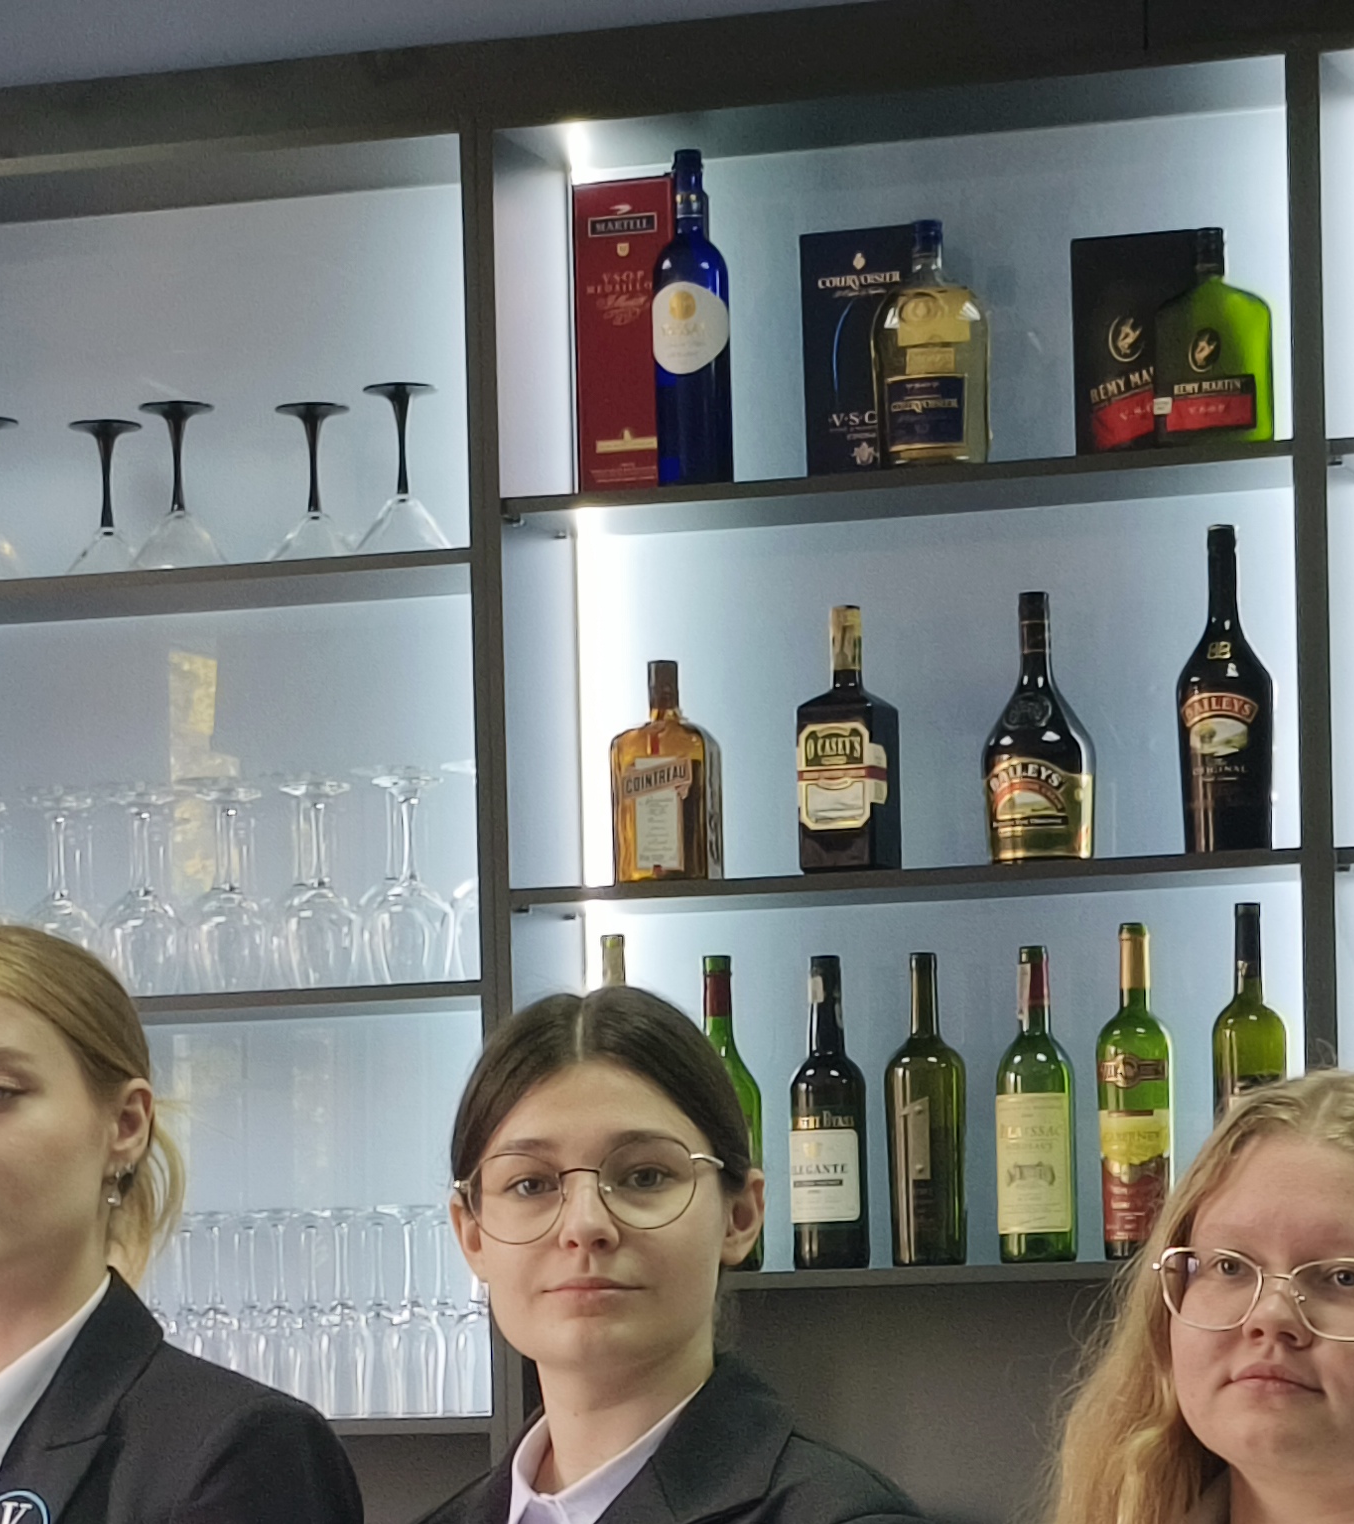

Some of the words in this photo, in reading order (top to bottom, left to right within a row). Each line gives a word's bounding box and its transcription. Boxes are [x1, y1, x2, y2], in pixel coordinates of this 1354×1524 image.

[595, 218, 650, 233] MARTELL
[1185, 697, 1252, 718] BAILEYS
[626, 765, 686, 794] COINTREAU
[989, 762, 1062, 791] BAILEYS
